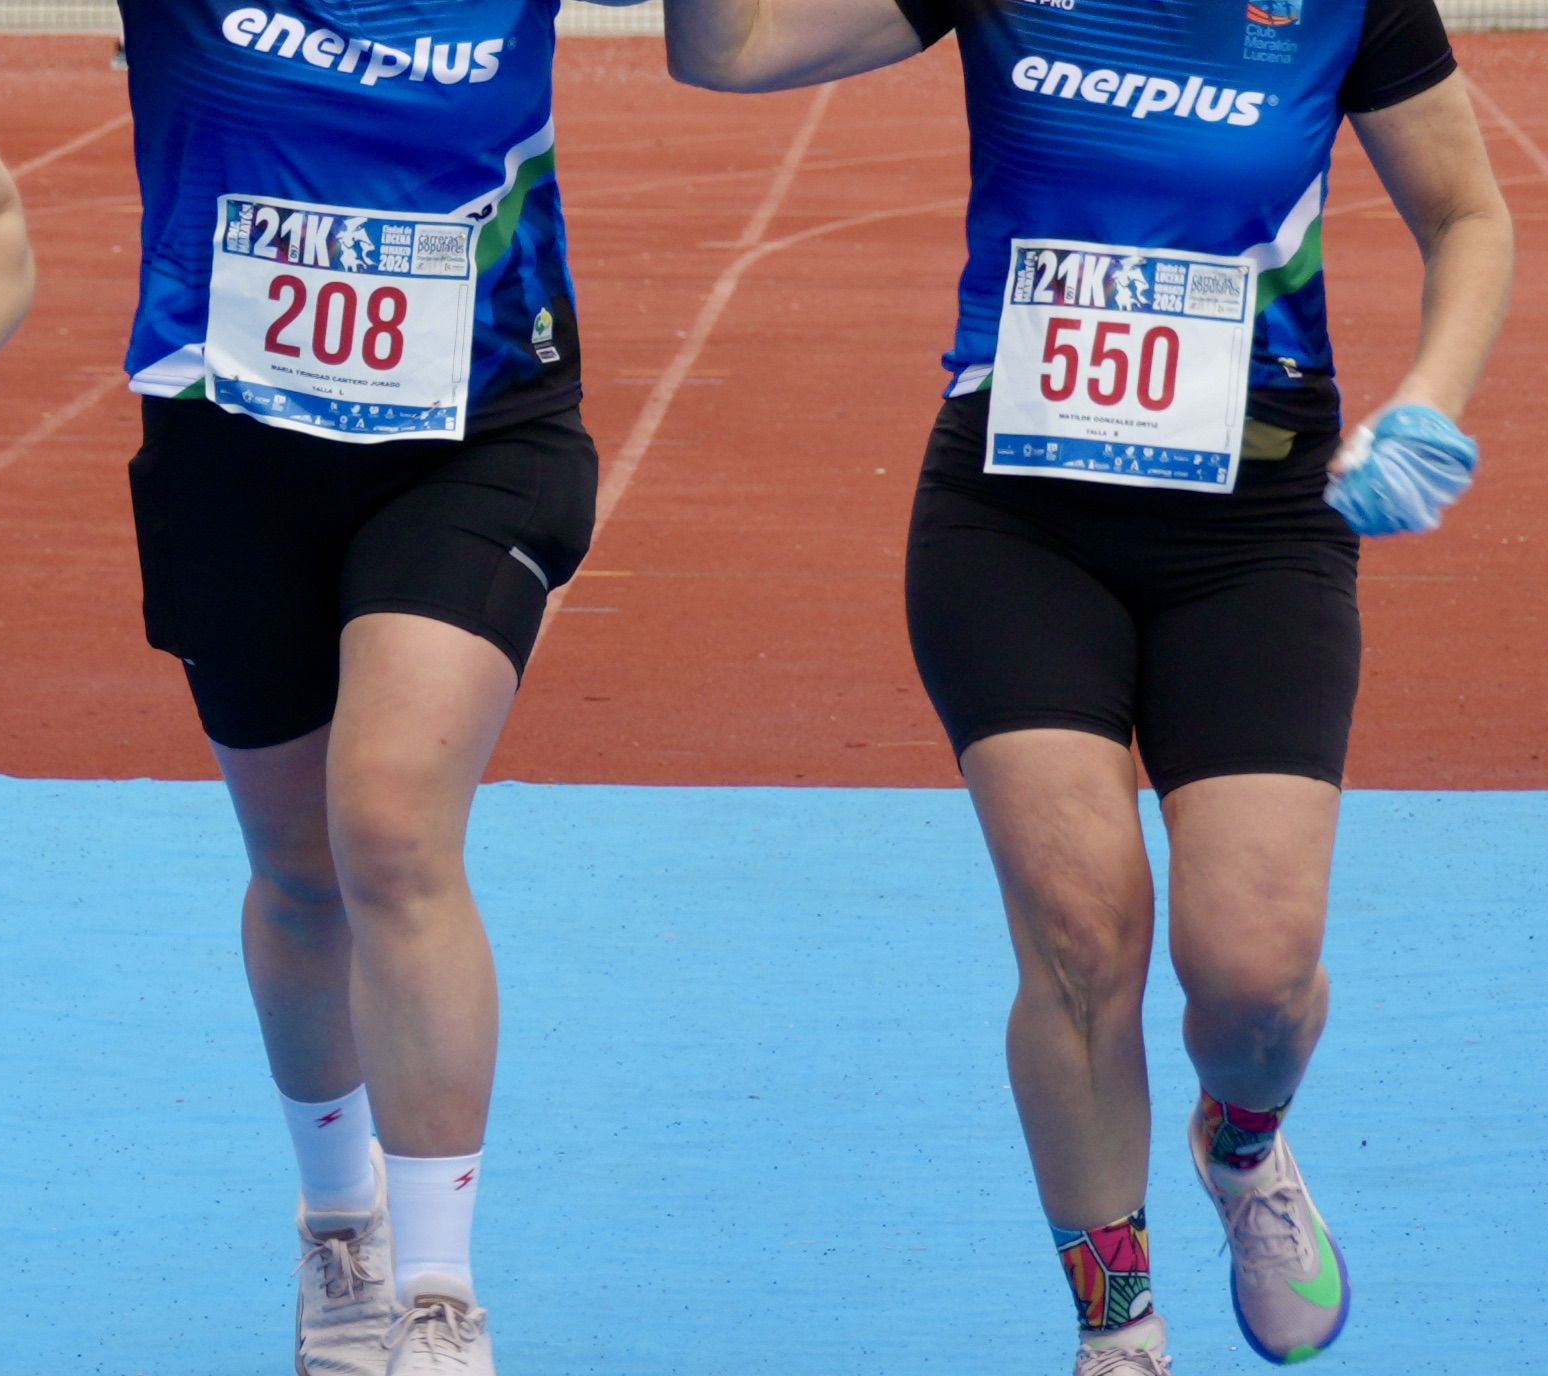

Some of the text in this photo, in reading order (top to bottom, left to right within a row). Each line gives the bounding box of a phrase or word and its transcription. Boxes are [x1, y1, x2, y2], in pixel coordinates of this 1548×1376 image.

[222, 8, 504, 85] enerplus
[1011, 56, 1265, 126] enerplus
[253, 207, 335, 267] 21K
[378, 255, 410, 273] 2026
[1034, 250, 1111, 307] 21K
[1153, 294, 1182, 312] 2026
[264, 274, 408, 371] 208
[1040, 317, 1179, 411] 550
